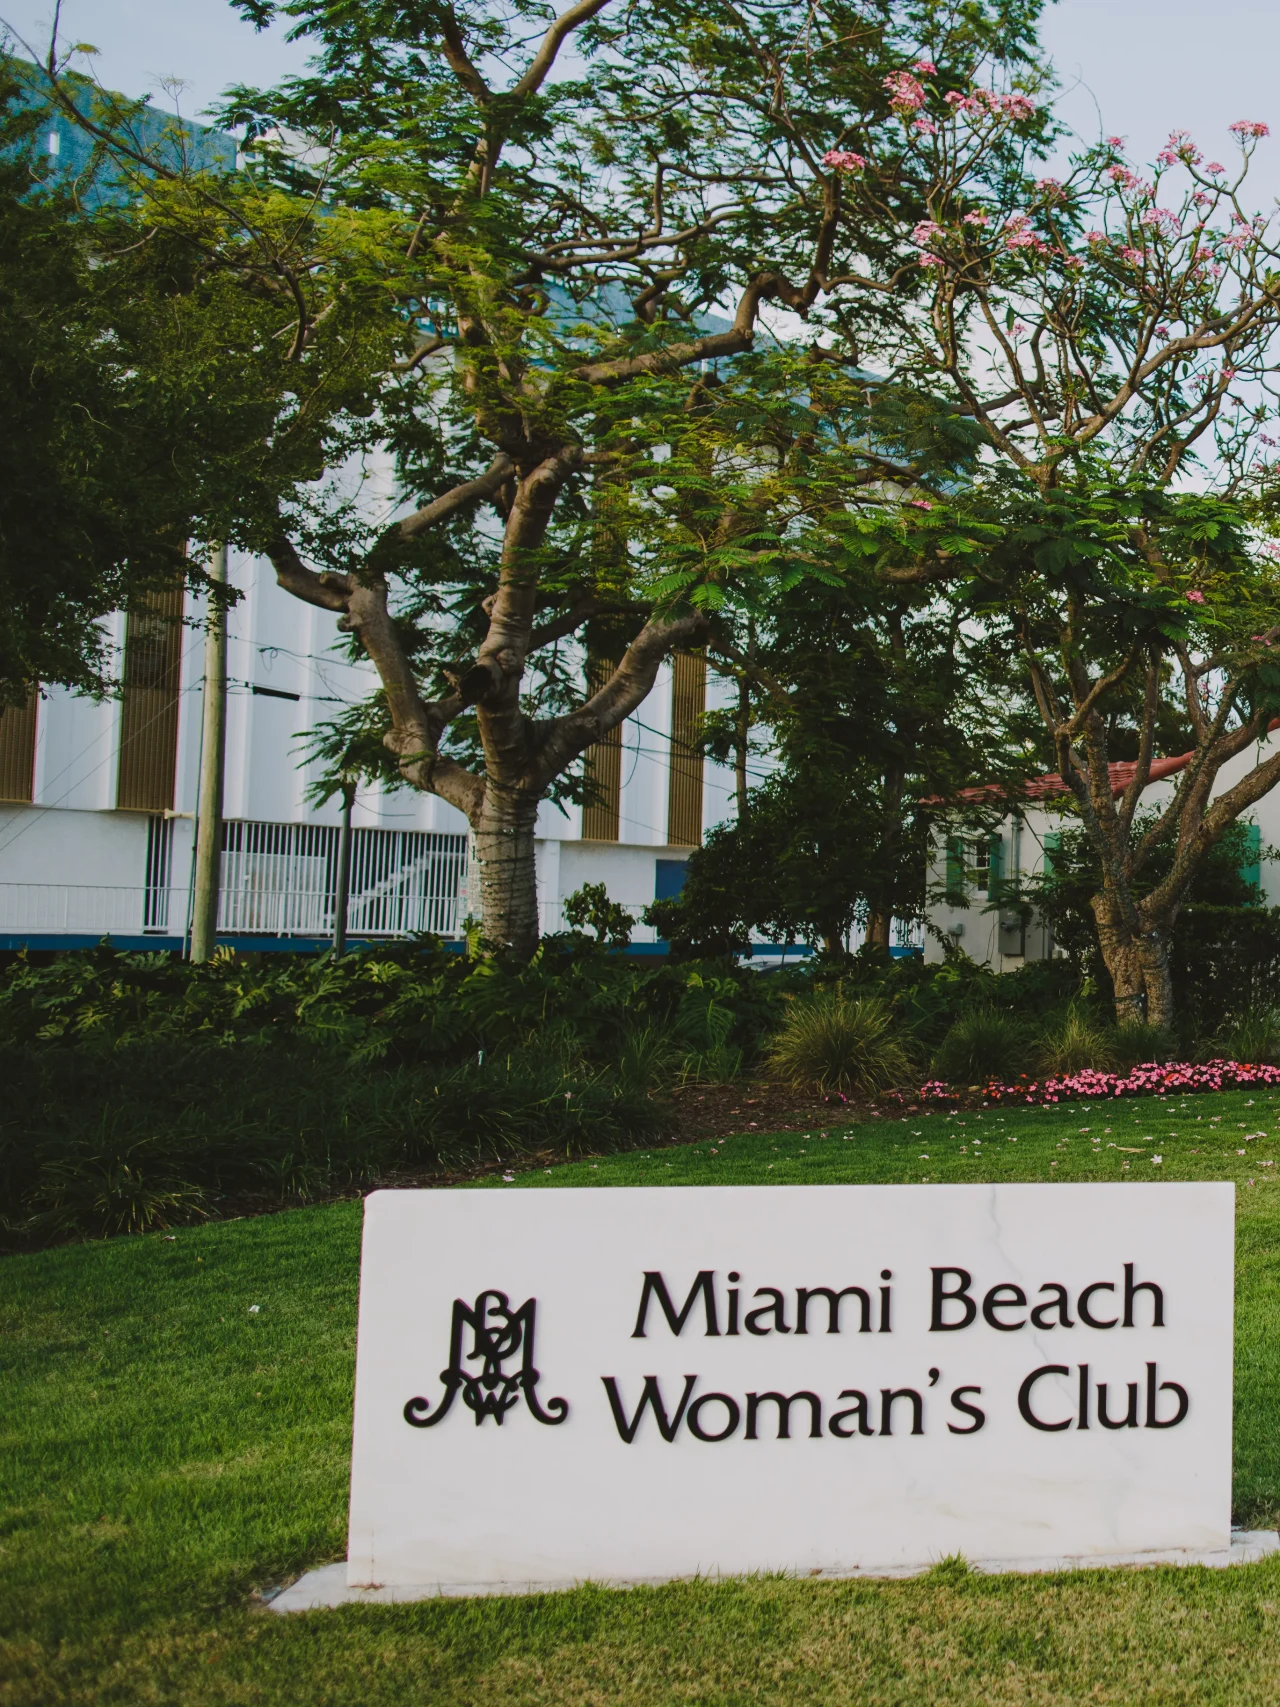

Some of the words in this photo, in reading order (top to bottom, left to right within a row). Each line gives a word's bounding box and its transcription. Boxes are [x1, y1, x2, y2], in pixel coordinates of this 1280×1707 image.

[630, 1267, 892, 1340] Miami
[928, 1262, 1165, 1332] Beach
[600, 1367, 986, 1445] Woman's
[1017, 1362, 1189, 1432] Club
